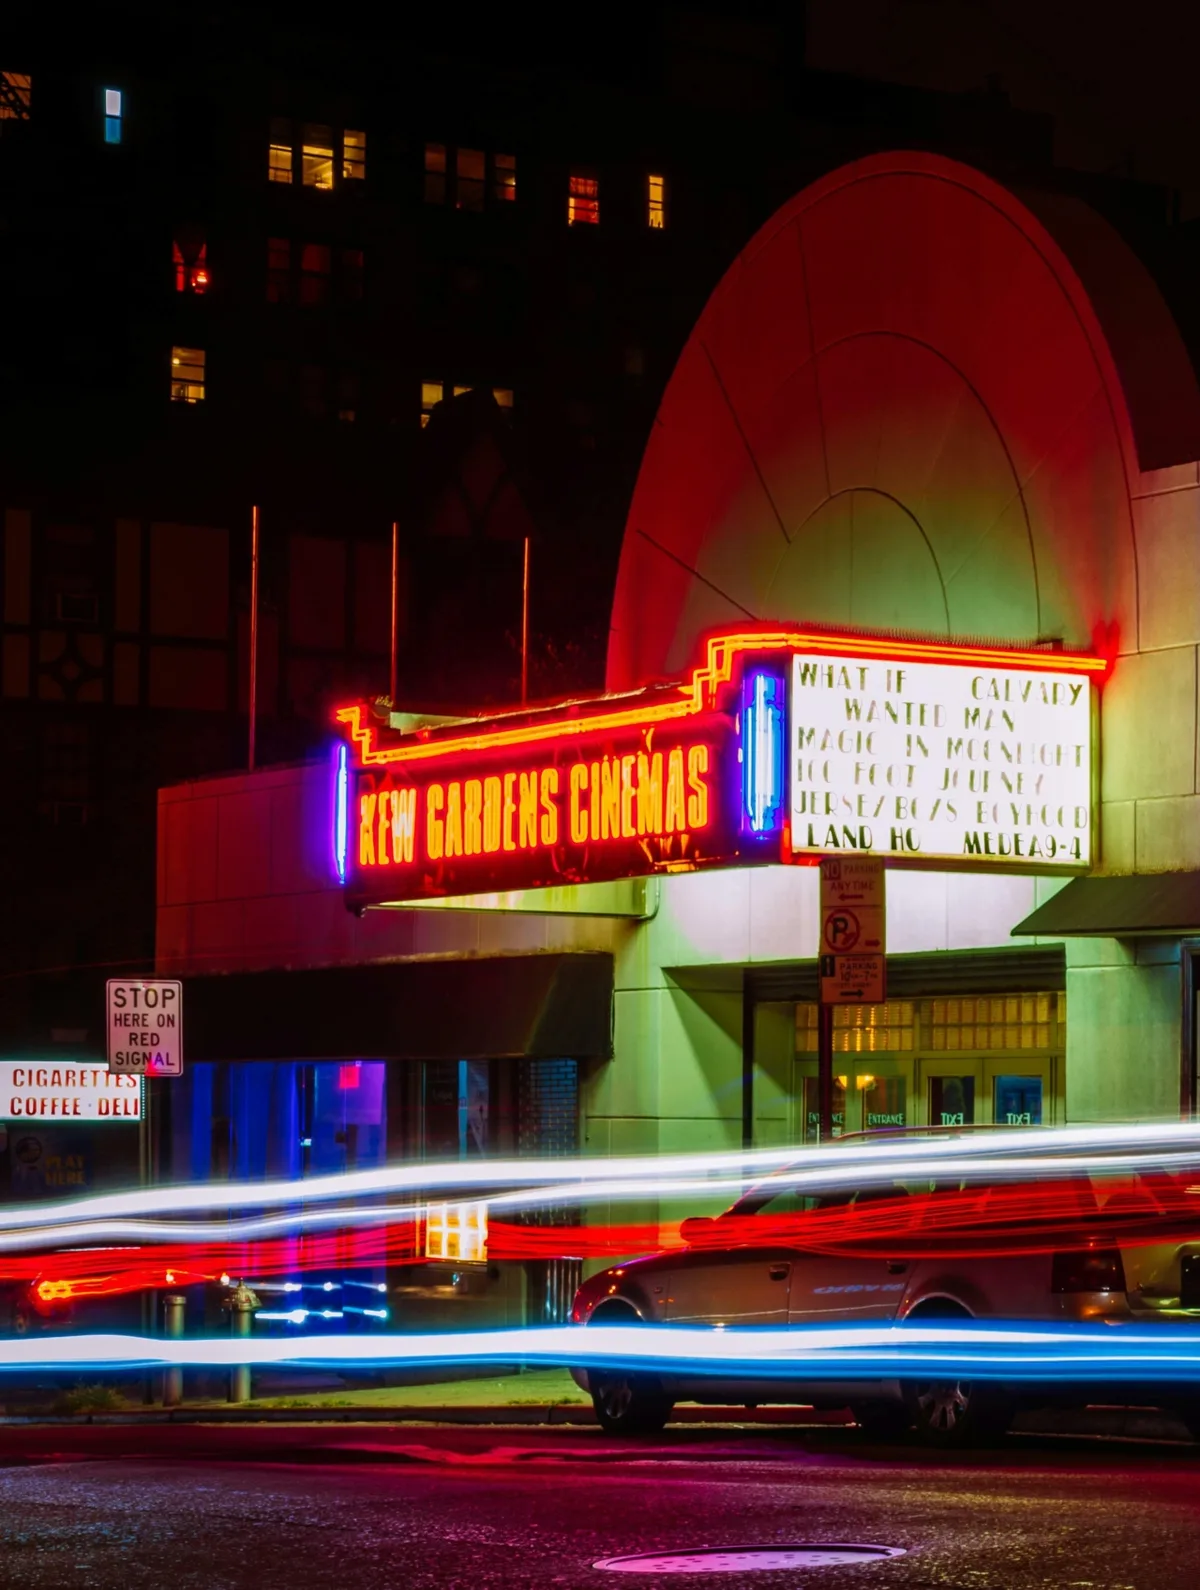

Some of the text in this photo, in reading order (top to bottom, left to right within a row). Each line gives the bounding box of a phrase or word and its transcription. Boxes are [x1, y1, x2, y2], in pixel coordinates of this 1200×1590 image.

[798, 662, 907, 694] WHAT IF
[971, 676, 1083, 706] CALVARY
[844, 698, 1016, 732] WANTED MAN
[797, 727, 878, 755] MAGIC
[906, 734, 929, 758] IN
[358, 744, 709, 866] KEW GARDENS CINEMAS
[807, 823, 921, 851] LAND HO
[830, 880, 876, 891] ANYTIME
[113, 987, 176, 1009] STOP
[114, 1013, 175, 1028] HERE ON
[129, 1032, 160, 1047] RED
[115, 1051, 175, 1067] SIGNAL
[12, 1068, 138, 1089] CIGARETTES
[10, 1096, 139, 1117] COFFEE DELI
[867, 1112, 904, 1126] ENTRANCE
